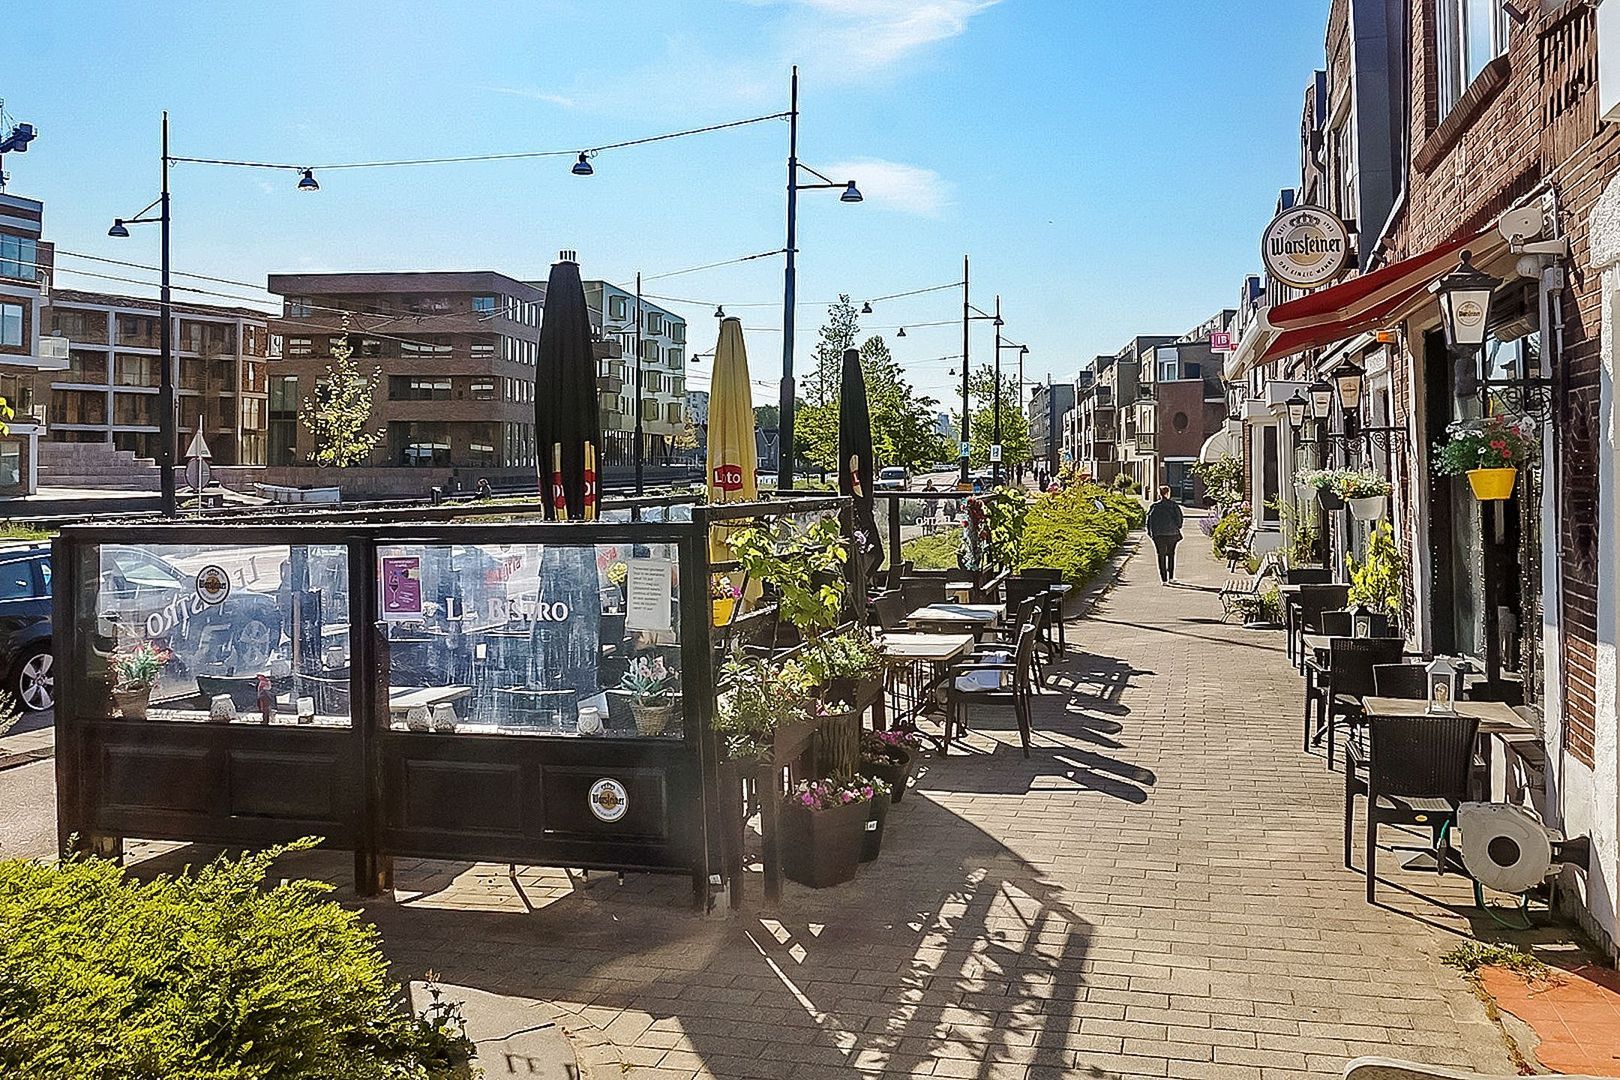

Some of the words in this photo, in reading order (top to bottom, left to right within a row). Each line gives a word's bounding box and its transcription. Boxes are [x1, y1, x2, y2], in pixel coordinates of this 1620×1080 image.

[1270, 233, 1341, 256] Warsteiner
[1278, 260, 1289, 271] DAS
[487, 597, 569, 622] BISTRO
